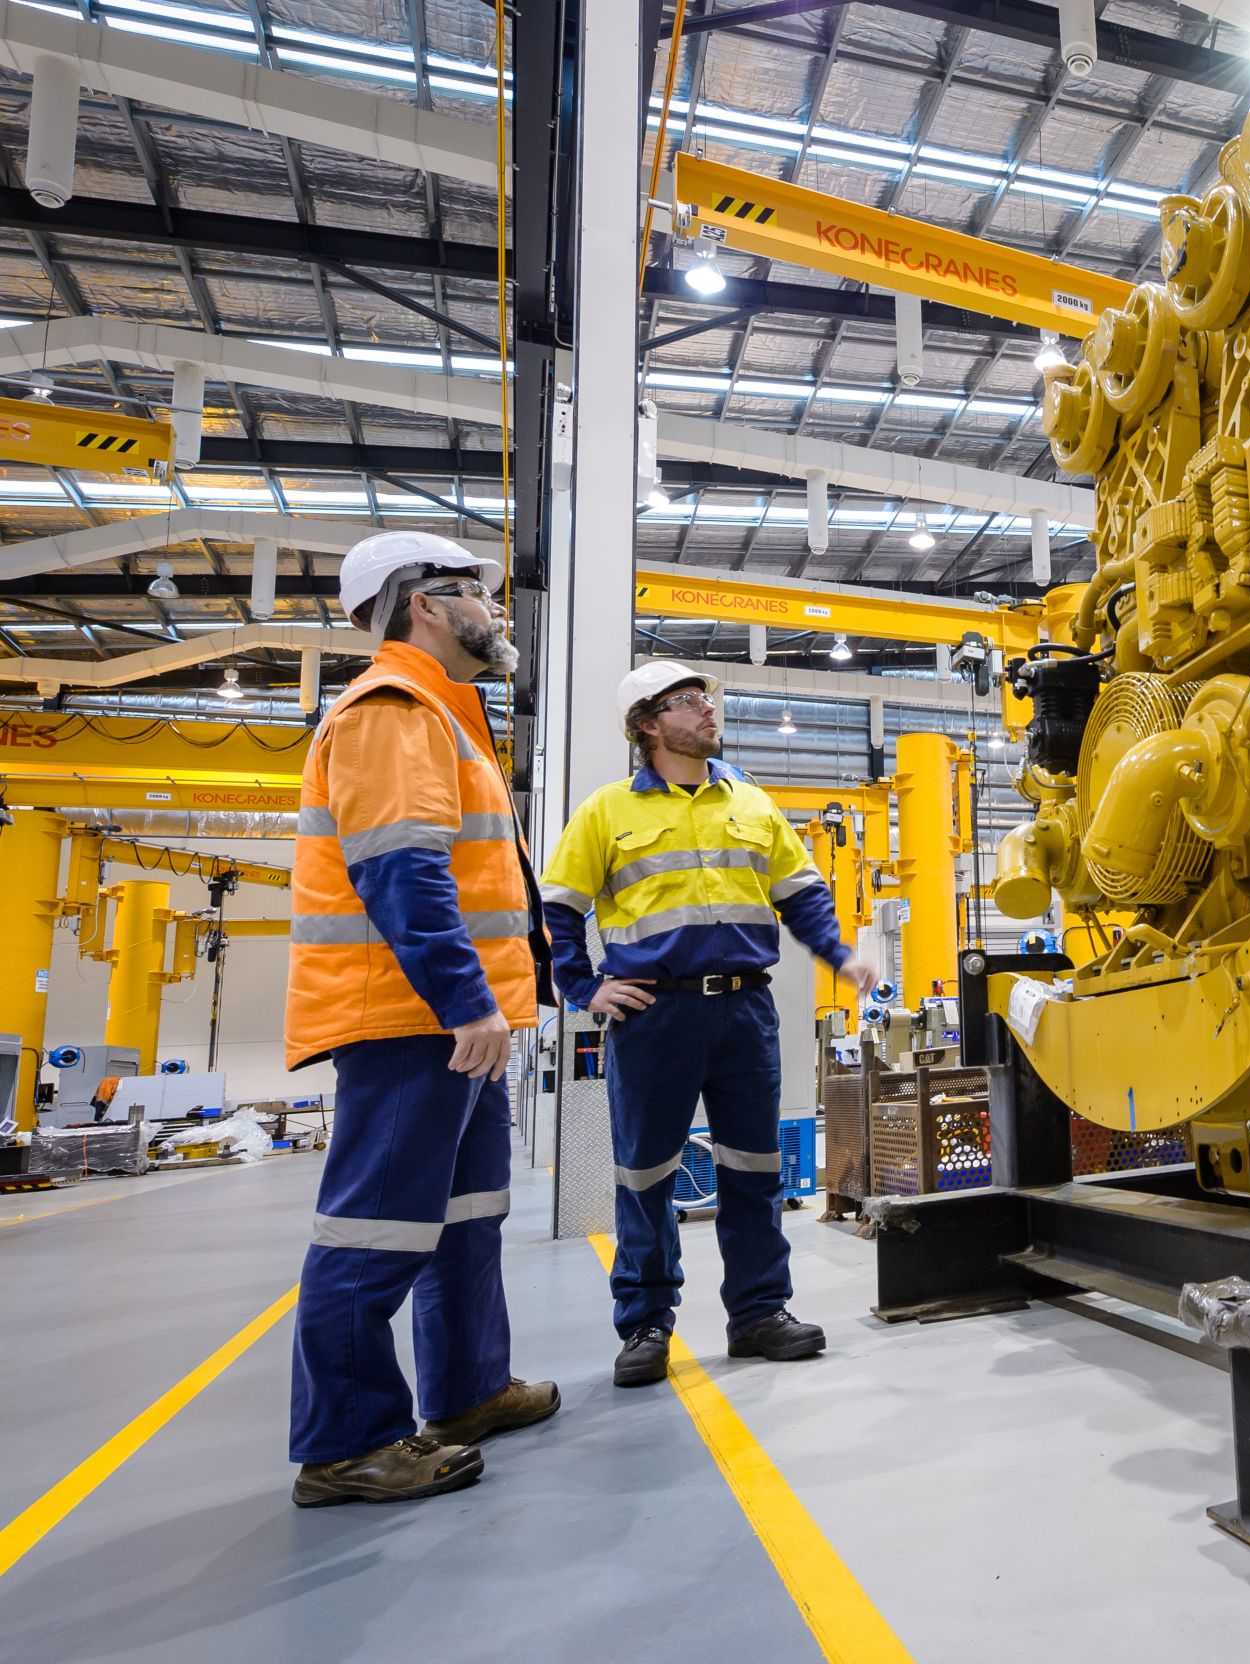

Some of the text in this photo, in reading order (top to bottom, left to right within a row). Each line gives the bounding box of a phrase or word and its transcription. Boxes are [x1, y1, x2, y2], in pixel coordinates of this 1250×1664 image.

[816, 221, 1018, 298] KONECRANES
[1057, 294, 1089, 311] 2000 kg
[671, 589, 789, 614] KONECRANES
[192, 792, 296, 806] KONECRANES
[919, 1053, 934, 1065] CAT
